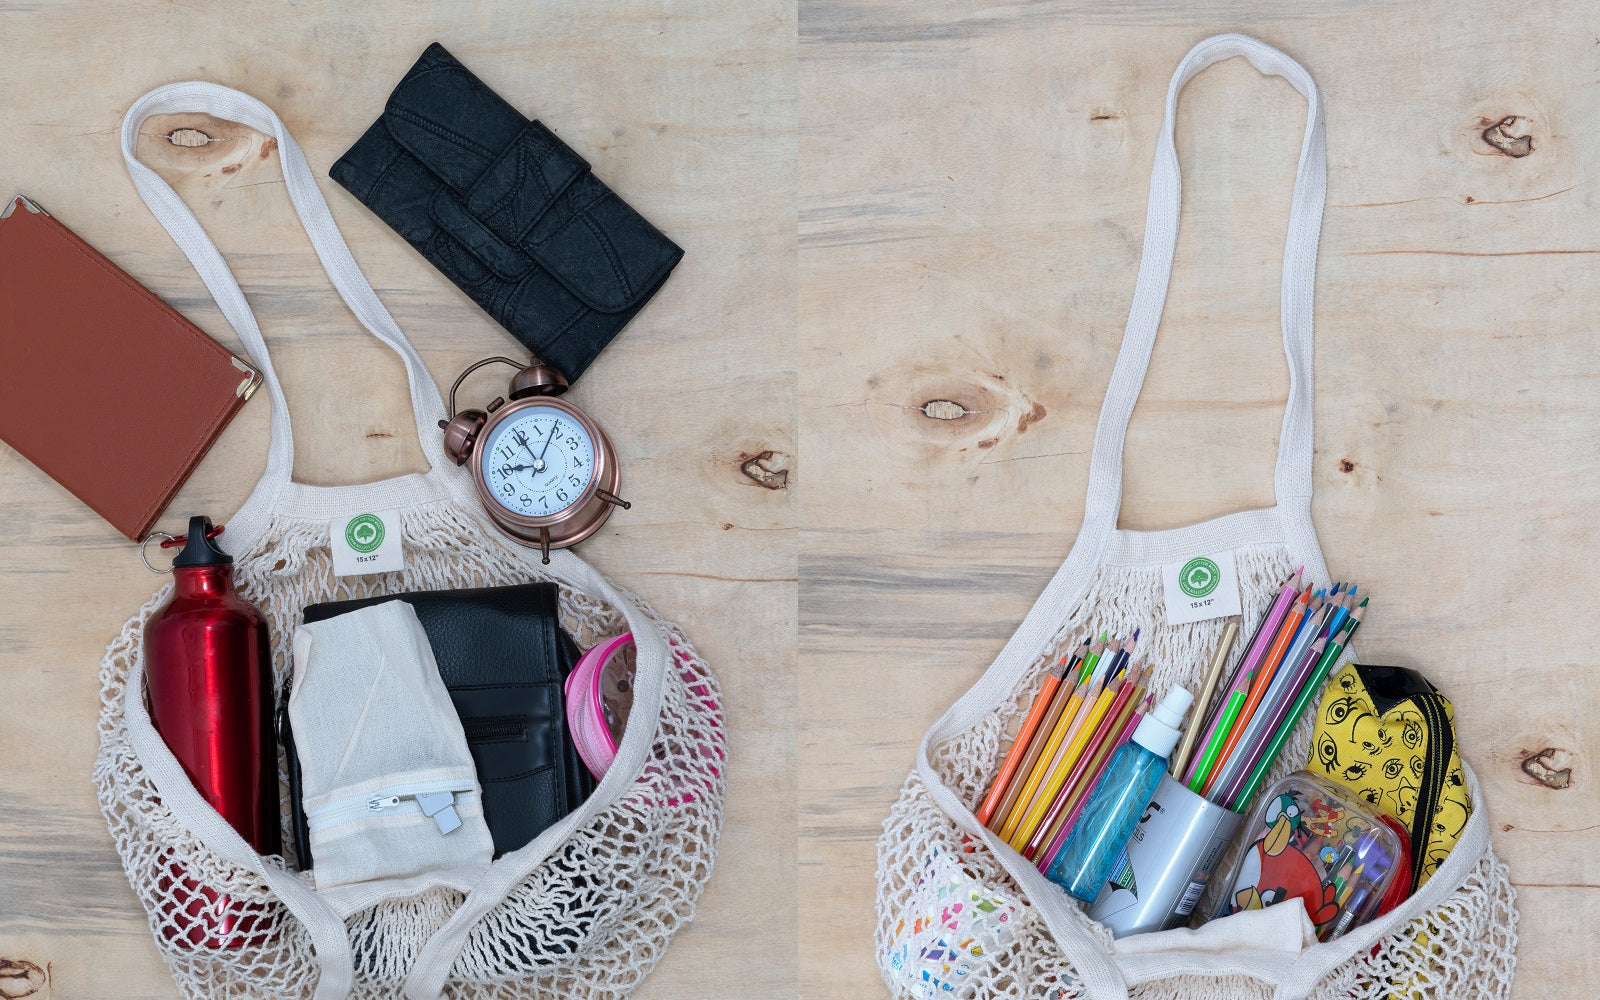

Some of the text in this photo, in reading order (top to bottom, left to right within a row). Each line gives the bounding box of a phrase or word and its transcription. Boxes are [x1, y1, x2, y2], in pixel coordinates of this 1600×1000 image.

[533, 425, 543, 437] 1
[553, 426, 563, 440] 2
[512, 430, 530, 447] 12
[566, 437, 578, 450] 3
[500, 445, 515, 461] 11
[573, 456, 584, 468] 4
[497, 463, 514, 480] 10
[544, 475, 559, 487] QUARTZ
[568, 474, 580, 487] 5
[503, 482, 516, 496] 9
[556, 488, 568, 501] 6
[520, 494, 532, 507] 8
[538, 495, 548, 508] 7
